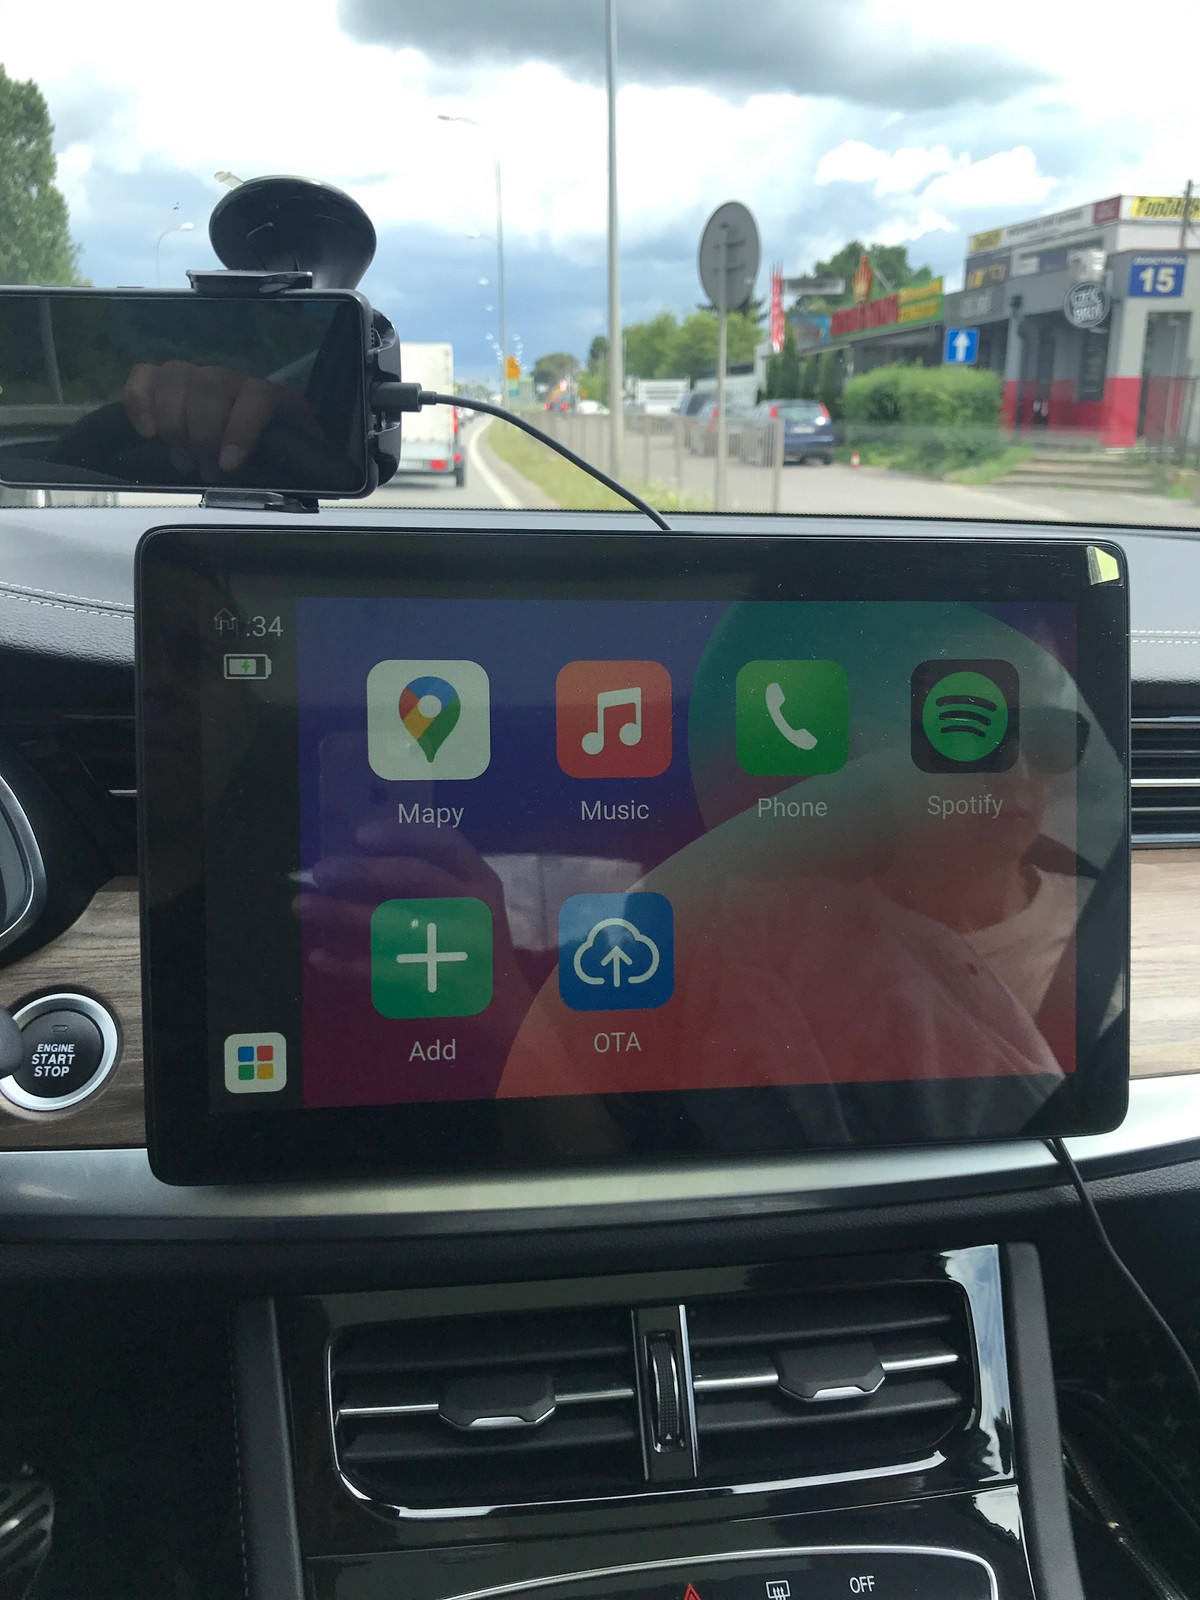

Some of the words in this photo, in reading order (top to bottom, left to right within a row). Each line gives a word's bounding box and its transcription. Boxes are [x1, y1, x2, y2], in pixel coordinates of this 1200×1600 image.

[1139, 266, 1175, 293] 15
[398, 803, 464, 828] Mapy
[581, 800, 649, 821] Music
[757, 798, 828, 817] Phone
[927, 794, 1003, 819] Spotify
[37, 1043, 75, 1053] ENGINE
[408, 1039, 456, 1062] Add
[593, 1031, 641, 1053] OTA
[31, 1053, 75, 1065] START
[33, 1065, 70, 1077] STOP
[850, 1575, 875, 1594] OFF
